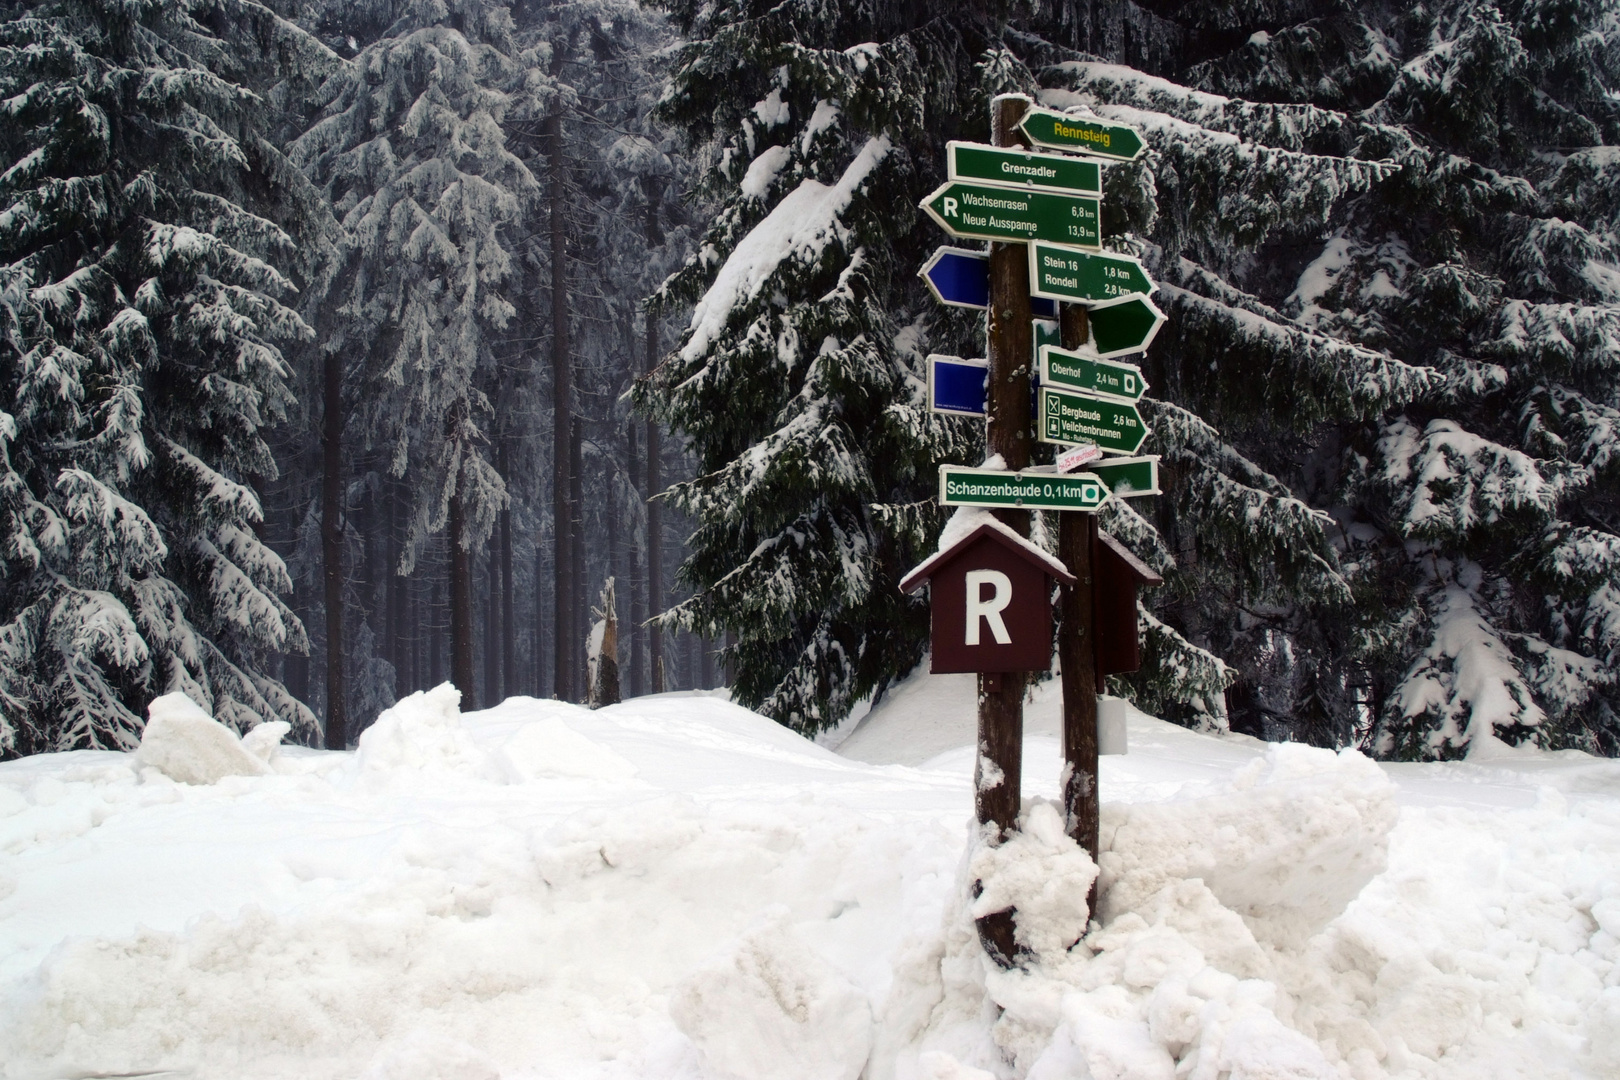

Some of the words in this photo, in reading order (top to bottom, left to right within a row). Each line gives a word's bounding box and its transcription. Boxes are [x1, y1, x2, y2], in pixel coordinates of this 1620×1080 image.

[1054, 122, 1111, 147] Rennsteig
[1001, 162, 1057, 178] Grenzadler
[943, 196, 958, 217] R
[962, 193, 1028, 211] Wachsenrasen
[1071, 206, 1084, 219] 6,8
[1085, 210, 1095, 218] km
[963, 213, 987, 227] Neue
[988, 215, 1038, 232] Ausspanne
[1068, 225, 1085, 237] 13,9
[1086, 229, 1095, 237] km
[1043, 256, 1066, 269] Stein
[1068, 260, 1078, 271] 16
[1103, 266, 1116, 278] 1,8
[1117, 268, 1130, 279] km
[1045, 273, 1078, 289] Rondell
[1104, 283, 1117, 296] 2,8
[1118, 285, 1131, 296] km
[1051, 362, 1081, 378] Oberhof
[1096, 372, 1107, 385] 2,4
[1107, 374, 1119, 387] km
[1061, 405, 1101, 421] Bergbaude
[1113, 414, 1125, 427] 2,6
[1125, 416, 1137, 427] km
[1061, 419, 1122, 440] Veilchenbrunnen
[947, 481, 1042, 498] Schanzenbaude
[1043, 484, 1062, 499] 0,1
[1063, 485, 1082, 498] km
[965, 569, 1013, 646] R
